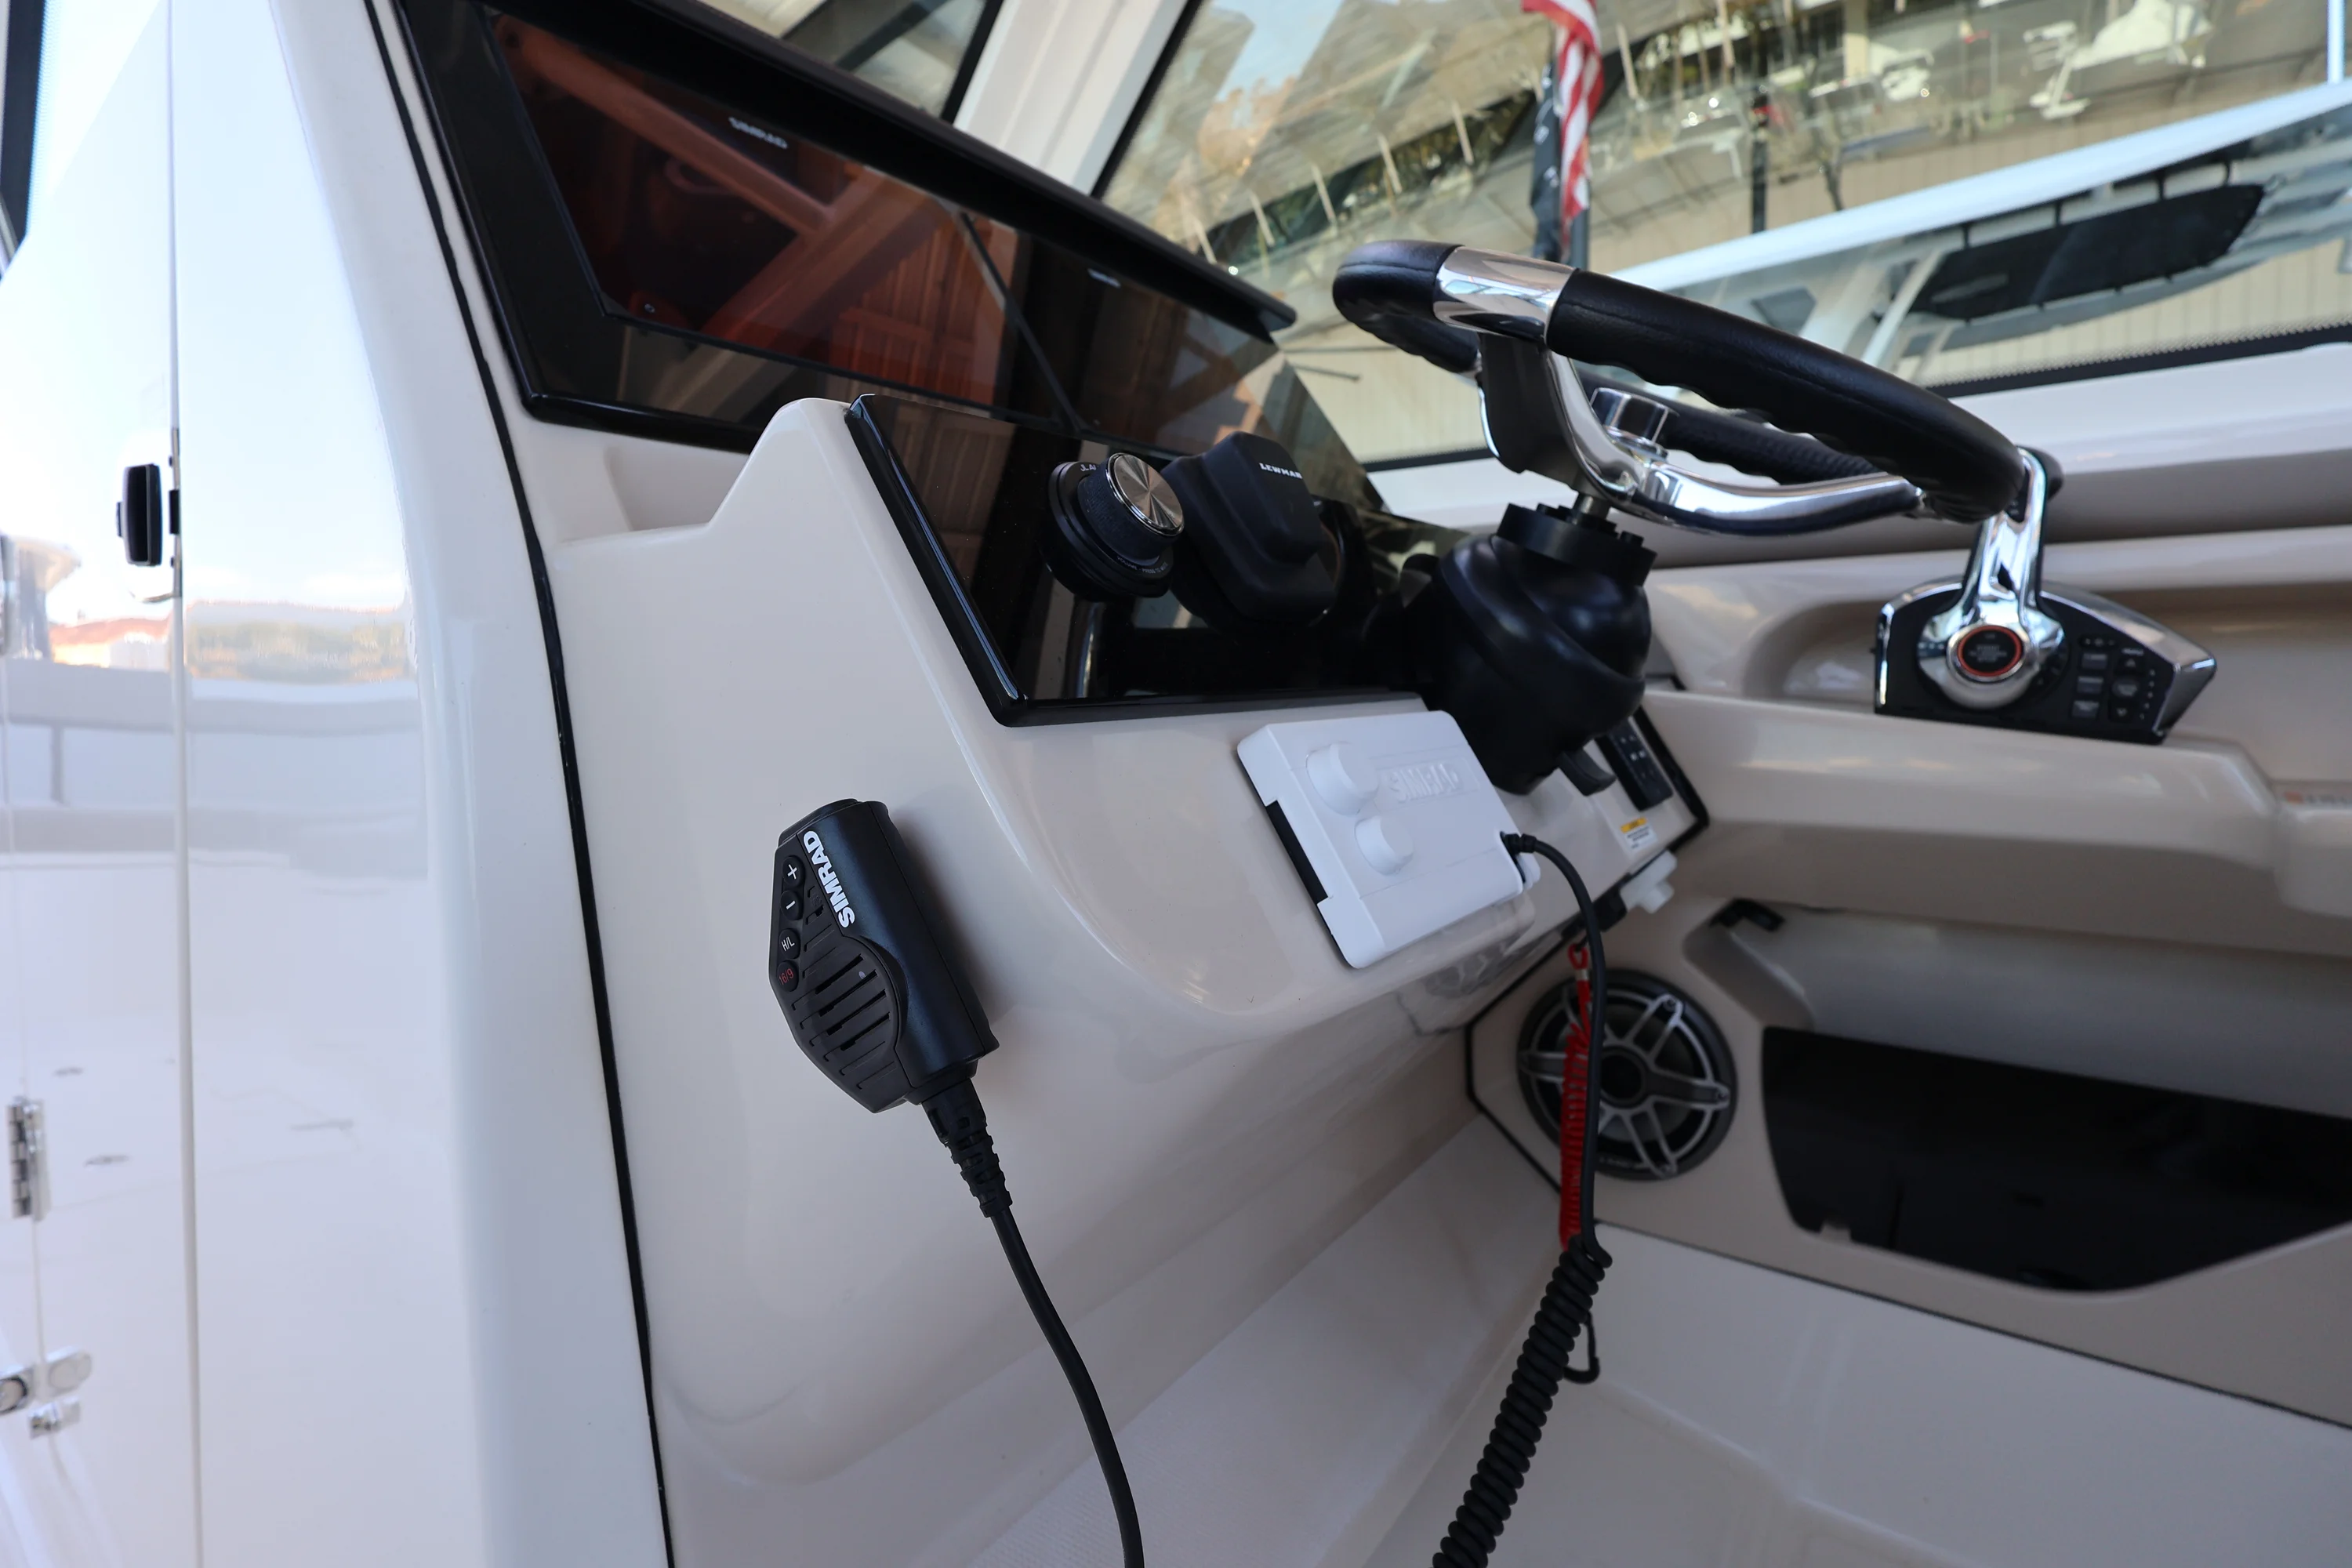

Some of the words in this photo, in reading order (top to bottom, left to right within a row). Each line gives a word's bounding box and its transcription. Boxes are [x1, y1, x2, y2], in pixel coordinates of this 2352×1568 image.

[1258, 463, 1303, 479] LEWMAR
[803, 831, 855, 927] SIMRAD
[781, 936, 795, 951] H/L
[779, 968, 794, 985] 16/9
